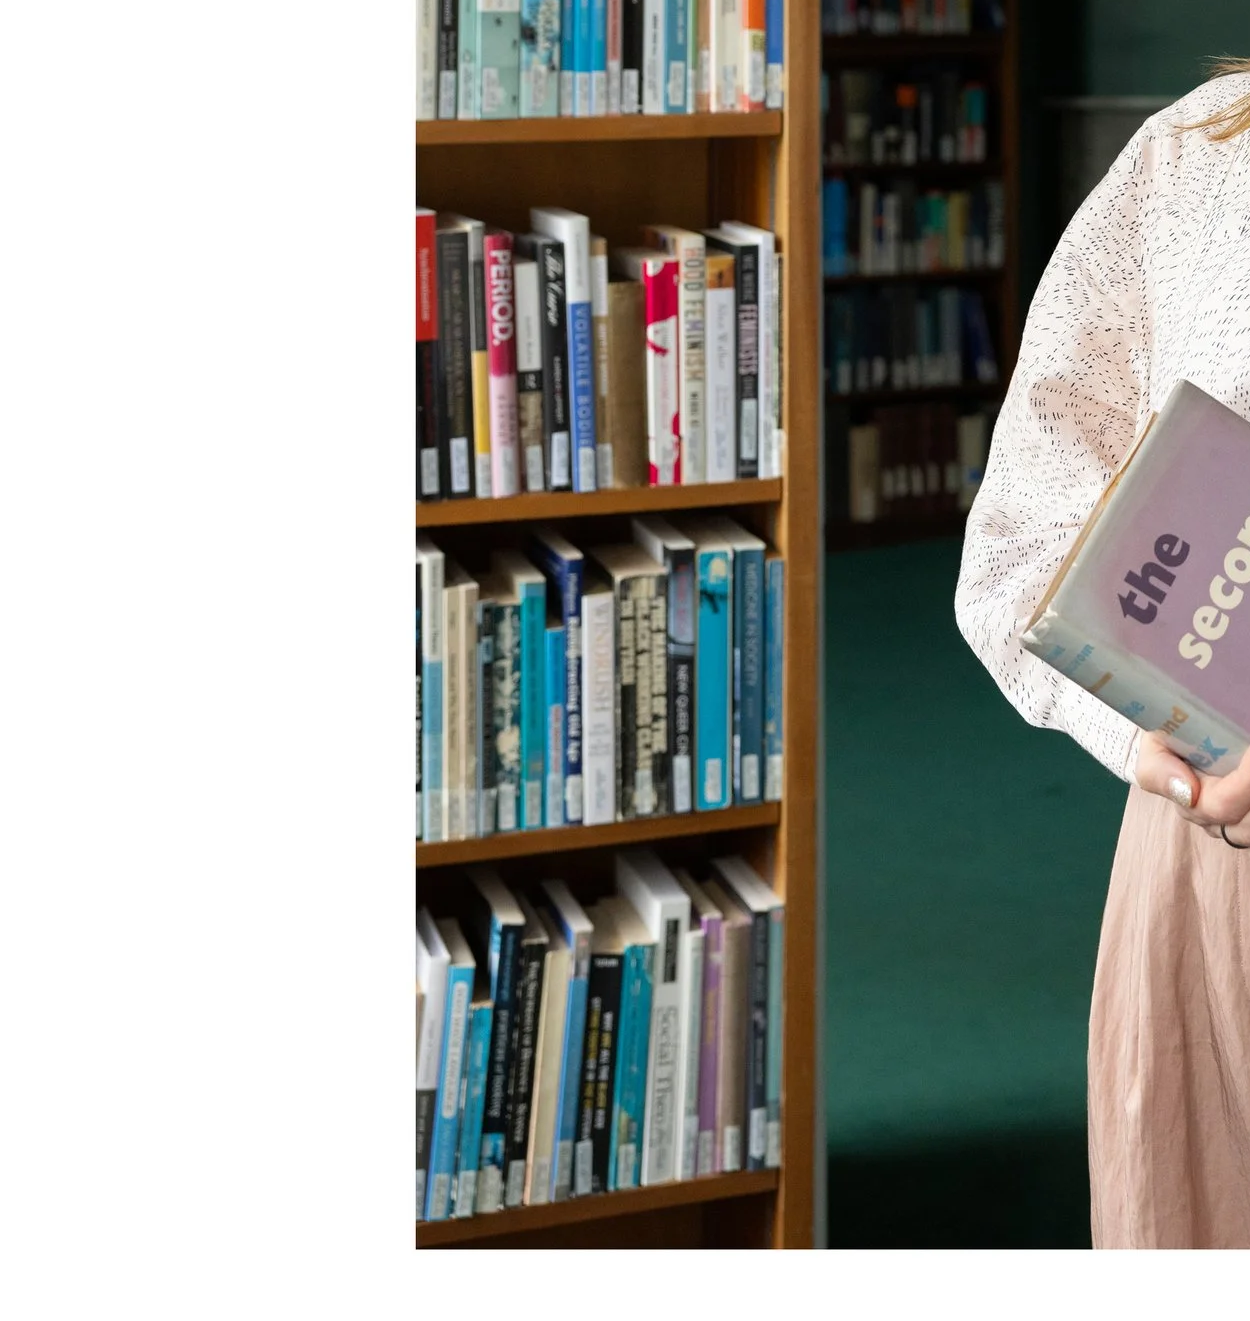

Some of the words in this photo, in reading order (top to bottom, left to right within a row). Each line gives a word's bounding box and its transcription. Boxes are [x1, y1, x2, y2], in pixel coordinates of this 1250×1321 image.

[490, 248, 513, 347] PERIOD.
[684, 247, 705, 291] HOOD
[574, 306, 591, 387] VOLATILE
[684, 299, 705, 382] FEMINISM
[717, 332, 728, 371] Walker
[739, 303, 759, 376] FEMINISTS
[577, 395, 595, 448] BODIE
[745, 561, 758, 618] MEDICINE
[1117, 532, 1191, 626] the
[593, 602, 615, 712] WINDRUSH
[651, 632, 667, 694] MAKING
[675, 663, 689, 692] NEW
[675, 694, 689, 732] QUEER
[658, 1005, 678, 1066] Social
[489, 1074, 506, 1117] looking
